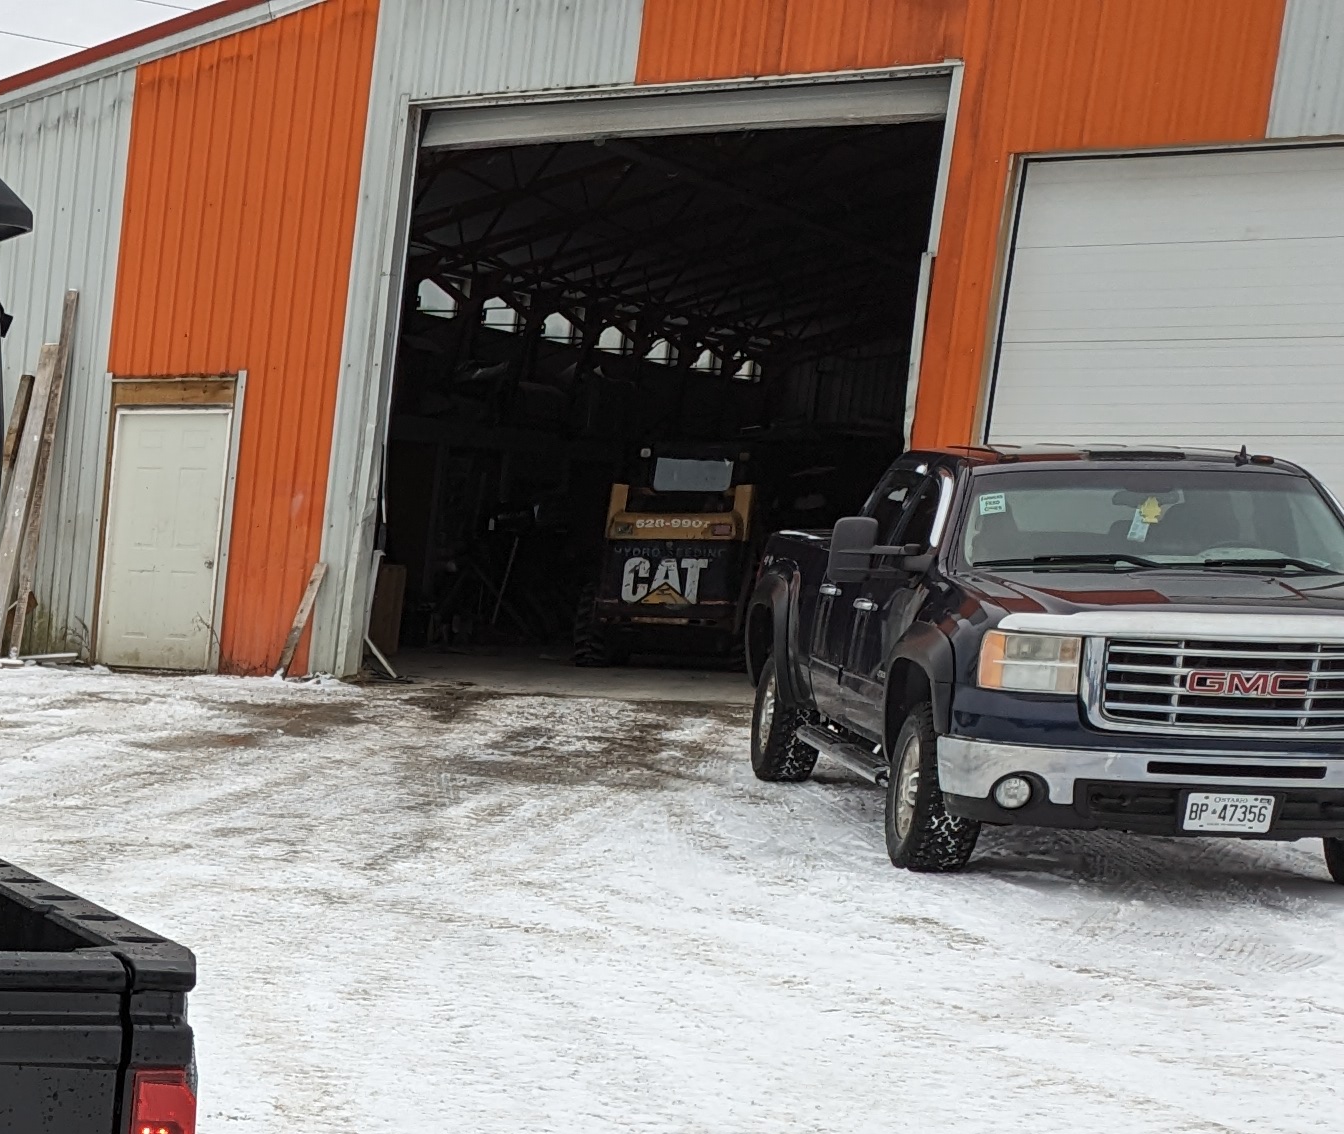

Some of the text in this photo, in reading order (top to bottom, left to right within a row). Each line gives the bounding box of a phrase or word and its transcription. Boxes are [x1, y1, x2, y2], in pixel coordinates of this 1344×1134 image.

[621, 557, 709, 604] CAT
[1186, 670, 1309, 696] GMC
[1188, 803, 1268, 823] BP 47356
